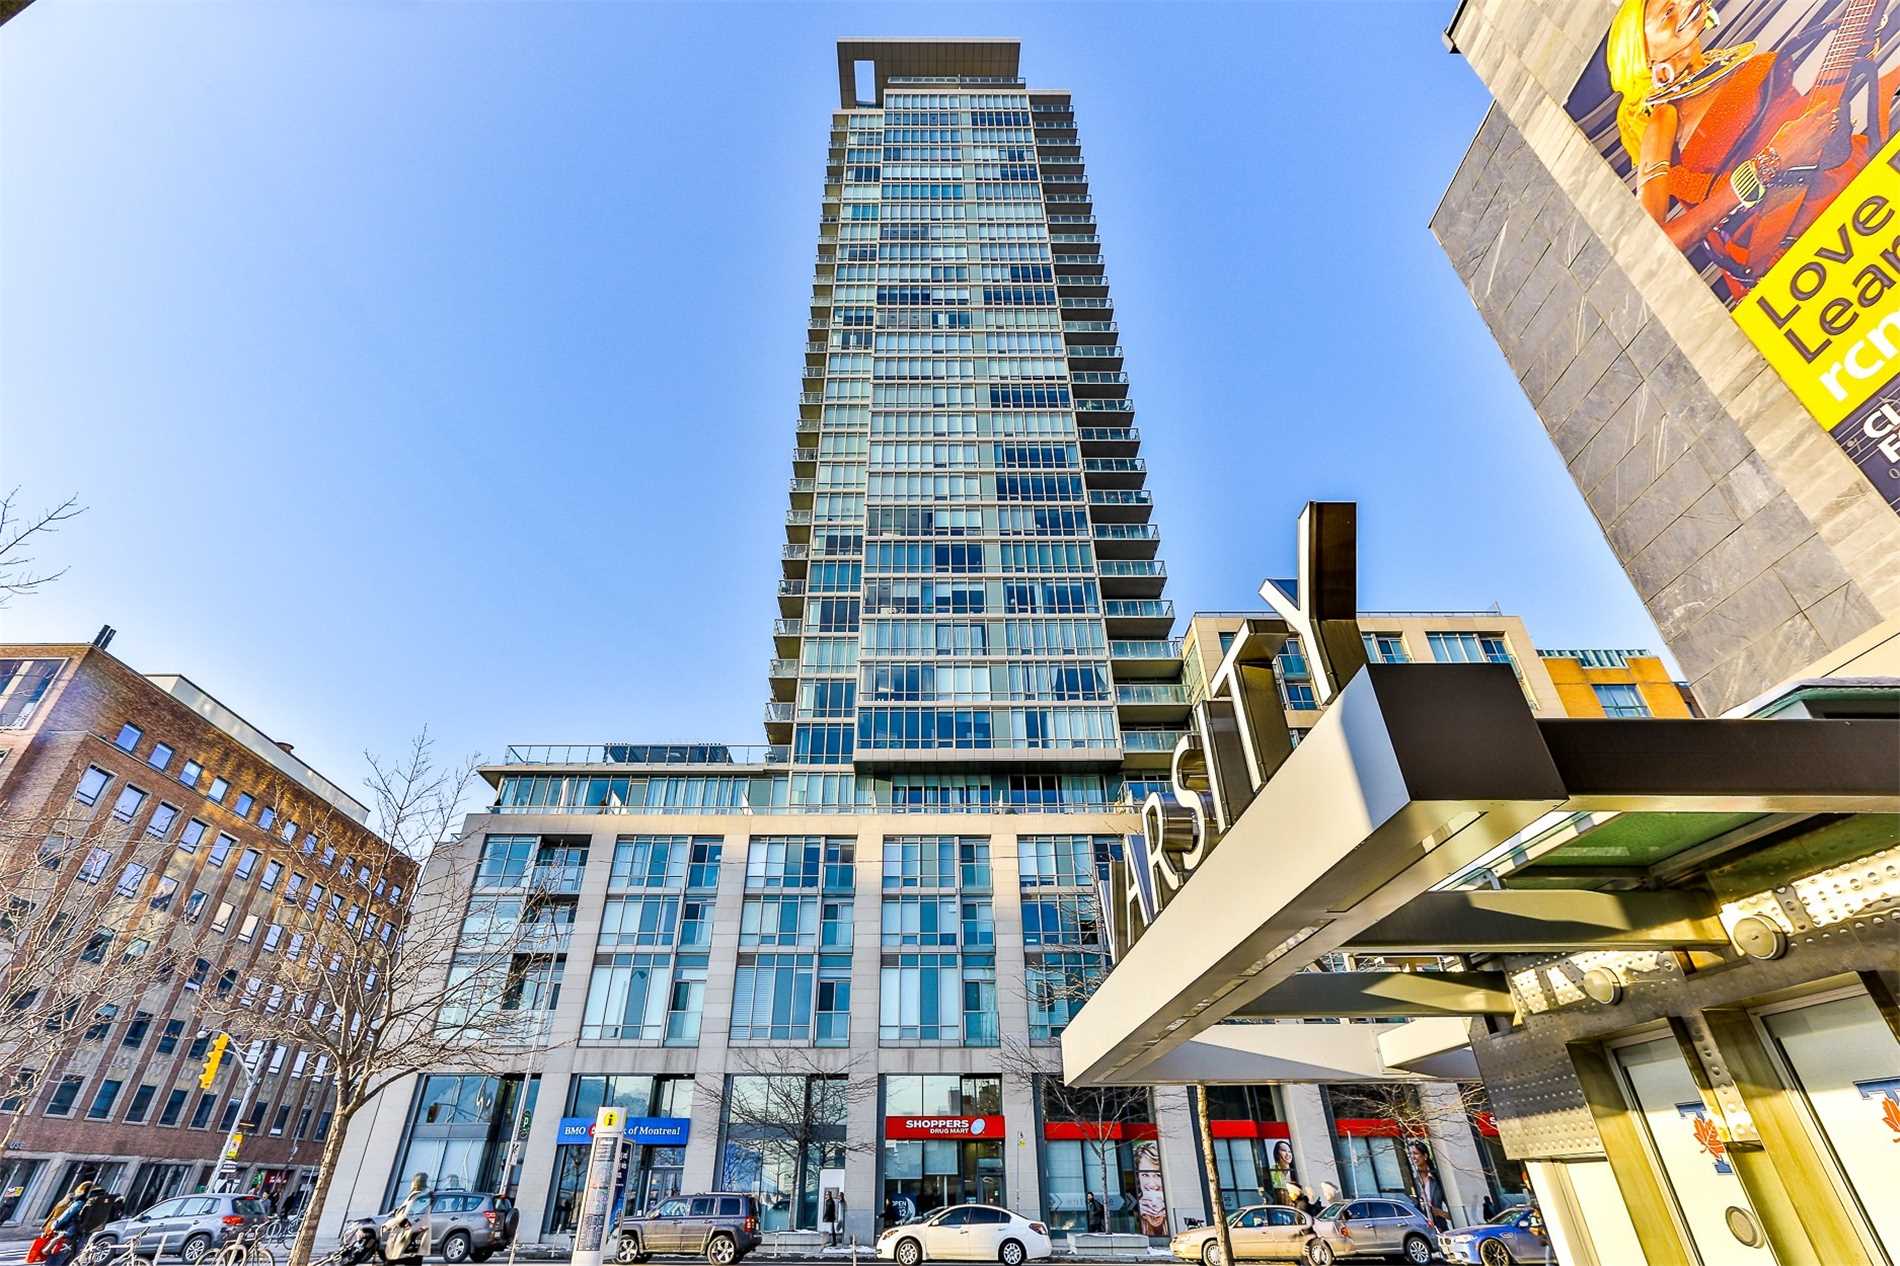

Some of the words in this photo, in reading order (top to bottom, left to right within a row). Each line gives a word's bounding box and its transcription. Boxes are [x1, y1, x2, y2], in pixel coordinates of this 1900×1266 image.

[1757, 196, 1895, 330] Love
[1098, 501, 1345, 966] VARSITY
[564, 1126, 586, 1136] BMO
[628, 1125, 638, 1136] of
[639, 1126, 681, 1136] Montreal
[906, 1119, 969, 1128] SHOPPERS
